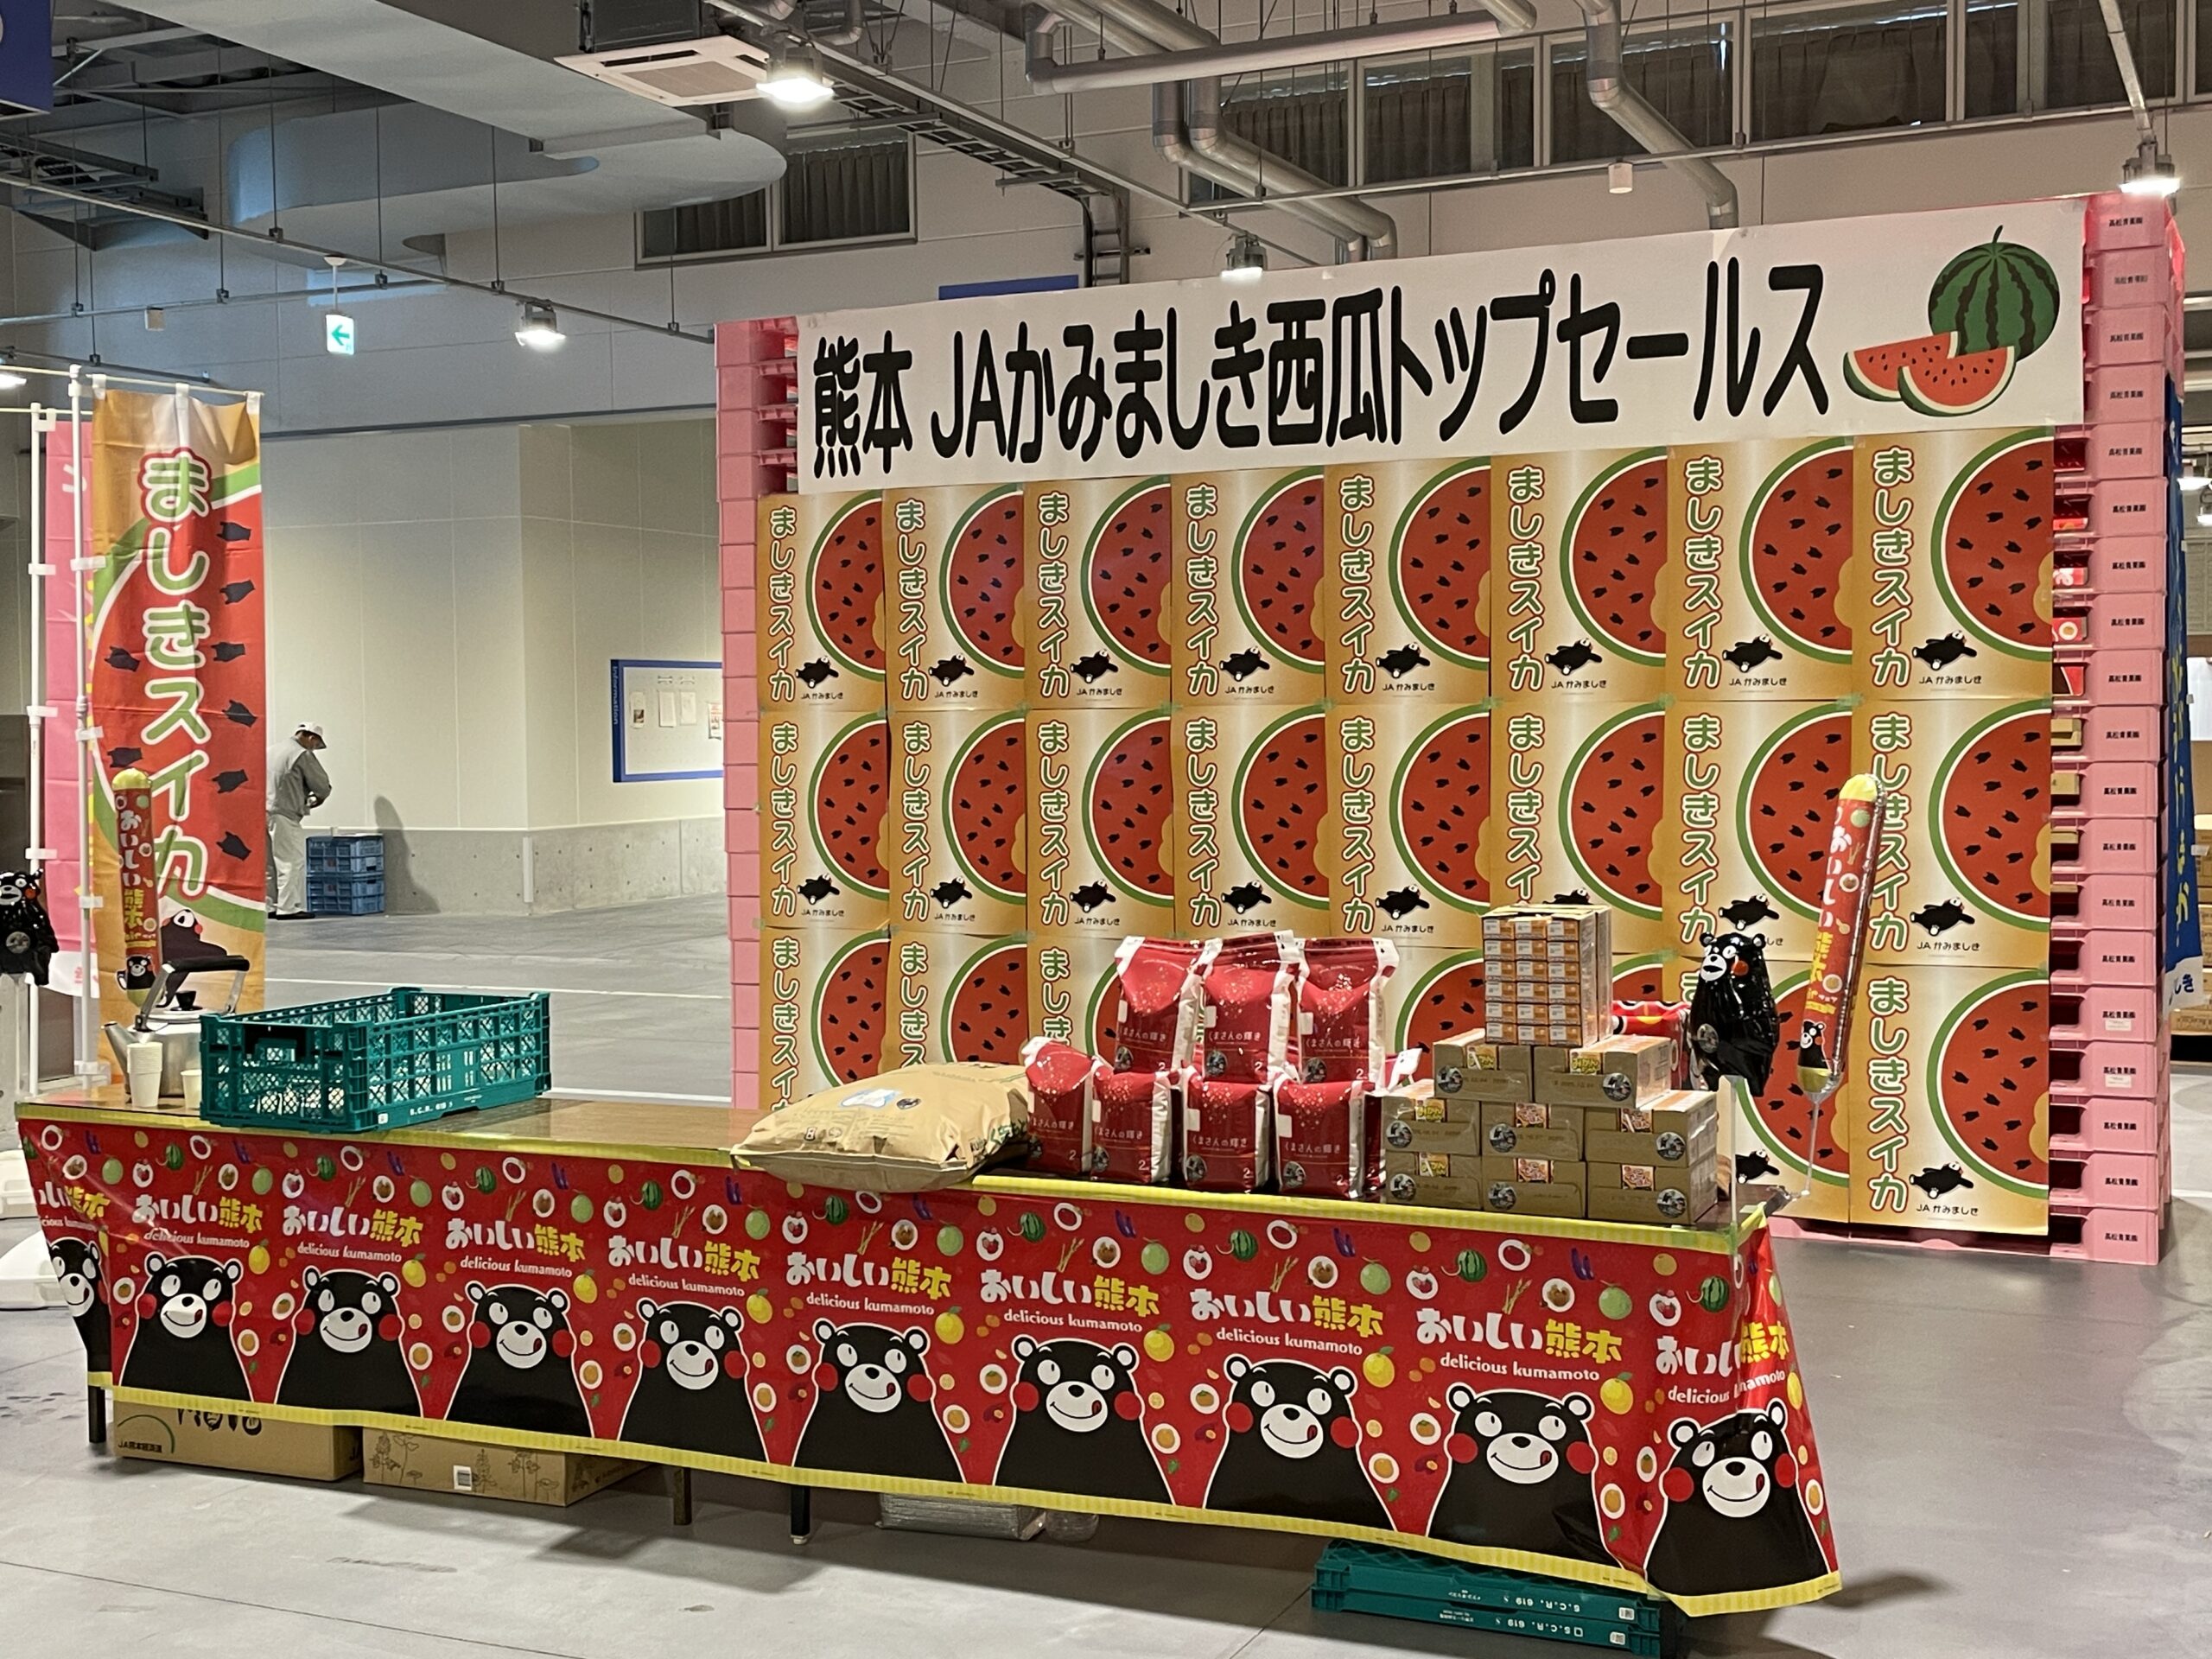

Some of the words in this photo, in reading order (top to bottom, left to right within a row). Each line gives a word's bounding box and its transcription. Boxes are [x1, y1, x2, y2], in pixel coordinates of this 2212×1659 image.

[813, 330, 913, 479] 熊本
[931, 257, 1829, 464] JAかみましき西瓜トップセールス
[769, 505, 796, 702] ましきスイカ
[895, 498, 929, 701] ましきスイカ
[1037, 491, 1071, 697] ましきスイカ
[1185, 482, 1219, 696] ましきスイカ
[1339, 474, 1375, 694] ましきスイカ
[1508, 465, 1545, 691] ましきスイカ
[1684, 455, 1723, 688] ましきスイカ
[1872, 446, 1914, 687] ましきスイカ
[139, 448, 213, 899] ましきスイカ
[771, 721, 798, 917] ましきスイカ
[902, 721, 931, 922] ましきスイカ
[1037, 720, 1070, 926] ましきスイカ
[1185, 716, 1221, 928] ましきスイカ
[1339, 715, 1375, 933] ましきスイカ
[1506, 712, 1544, 904] ましきスイ
[899, 941, 929, 1065] ましきス
[1039, 946, 1072, 1046] ましき
[1868, 976, 1909, 1212] ましきスイカ
[132, 1194, 263, 1233] おいしい熊本
[197, 1231, 249, 1249] kumamoto
[283, 1205, 423, 1248] おいしい熊本
[297, 1242, 340, 1258] delicious
[342, 1245, 402, 1262] kumamoto
[445, 1217, 586, 1262] おいしい熊本
[460, 1255, 511, 1273] delicious
[514, 1262, 573, 1278] kumamoto
[607, 1235, 760, 1281] おいしい熊本
[628, 1273, 679, 1290] delicious
[682, 1280, 745, 1297] kumamoto
[785, 1251, 952, 1300] おいしい熊本
[806, 1292, 860, 1310] delicious
[863, 1297, 935, 1316] kumamoto
[979, 1268, 1160, 1318] おいしい熊本
[1003, 1307, 1065, 1327] delicious
[1067, 1313, 1143, 1333] kumamoto
[1190, 1287, 1383, 1338] おいしい熊本
[1216, 1326, 1281, 1345] delicious
[1284, 1332, 1363, 1356] kumamoto
[1415, 1307, 1623, 1363] おいしい熊本
[1440, 1351, 1508, 1375] delicious
[1512, 1361, 1599, 1381] kumamoto
[1668, 1385, 1730, 1404] delicious
